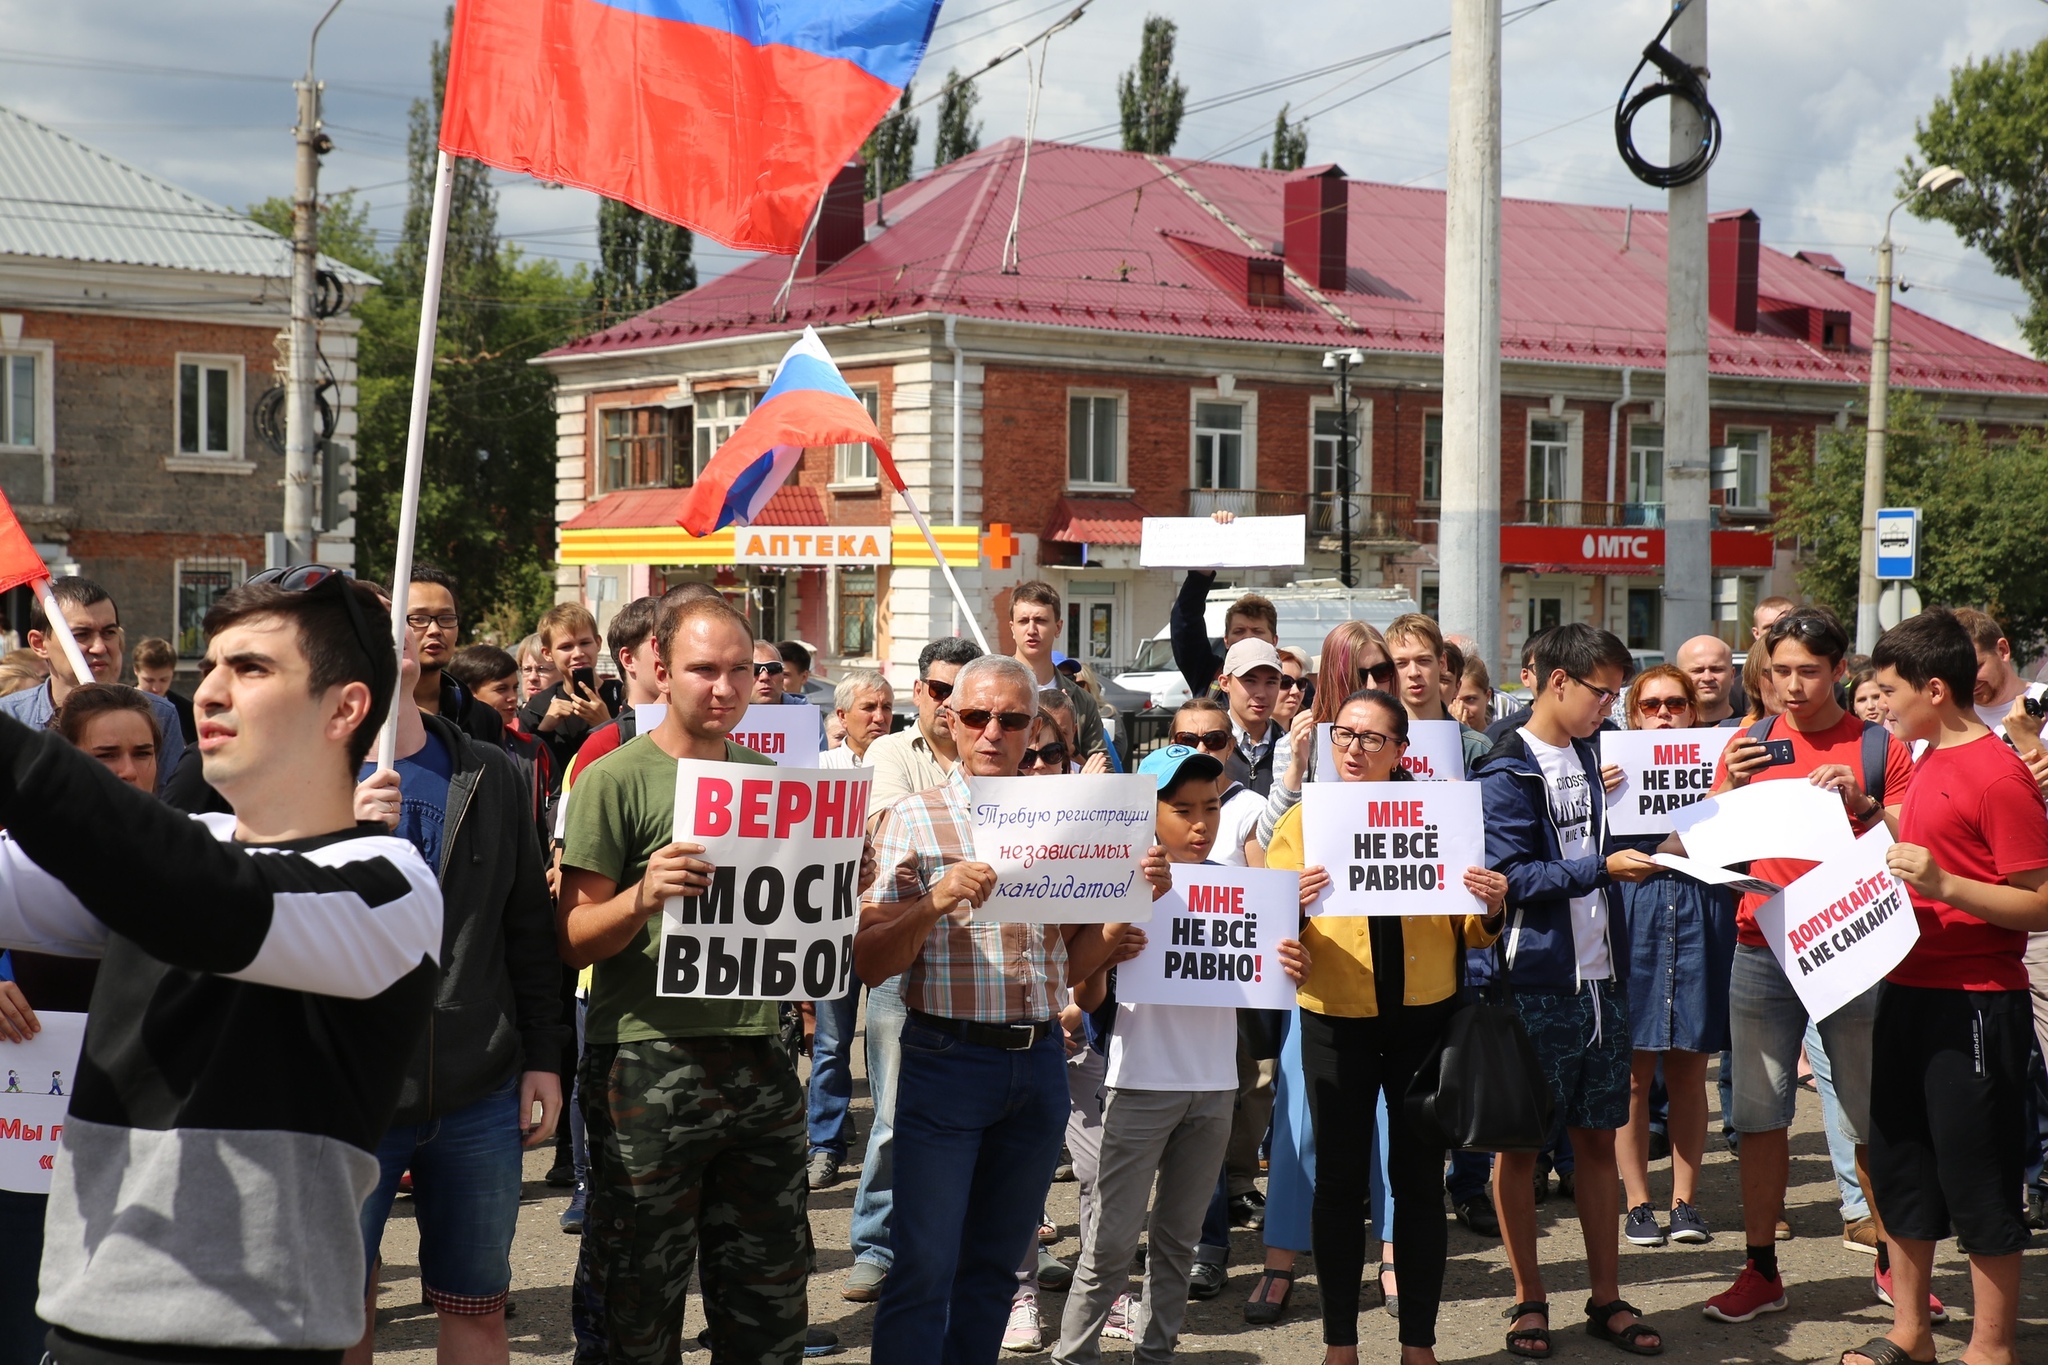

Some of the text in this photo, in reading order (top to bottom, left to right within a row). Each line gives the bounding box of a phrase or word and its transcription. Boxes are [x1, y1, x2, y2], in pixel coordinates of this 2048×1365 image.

[745, 534, 880, 557] АПТЕКА
[1597, 535, 1649, 558] МТС
[1654, 744, 1701, 766] МНЕ
[1643, 762, 1713, 790] НЕ ВСЁ
[977, 804, 1149, 829] Требую регистрации
[1368, 801, 1424, 827] МНЕ
[1354, 824, 1439, 859] НЕ ВСЁ
[1000, 843, 1133, 869] независимых
[996, 870, 1135, 899] кандидатов!
[1349, 864, 1445, 891] РАВНО!
[682, 860, 856, 925] МОСК
[1188, 885, 1244, 914] МНЕ
[1788, 870, 1893, 954] ДОПУСКАЙТЕ,
[1172, 912, 1257, 948] НЕ ВСЁ
[1797, 888, 1902, 976] А НЕ САЖАЙТЕ!
[662, 934, 853, 998] ВЫБОР
[1165, 951, 1262, 982] РАВНО!
[0, 1117, 43, 1141] Мы
